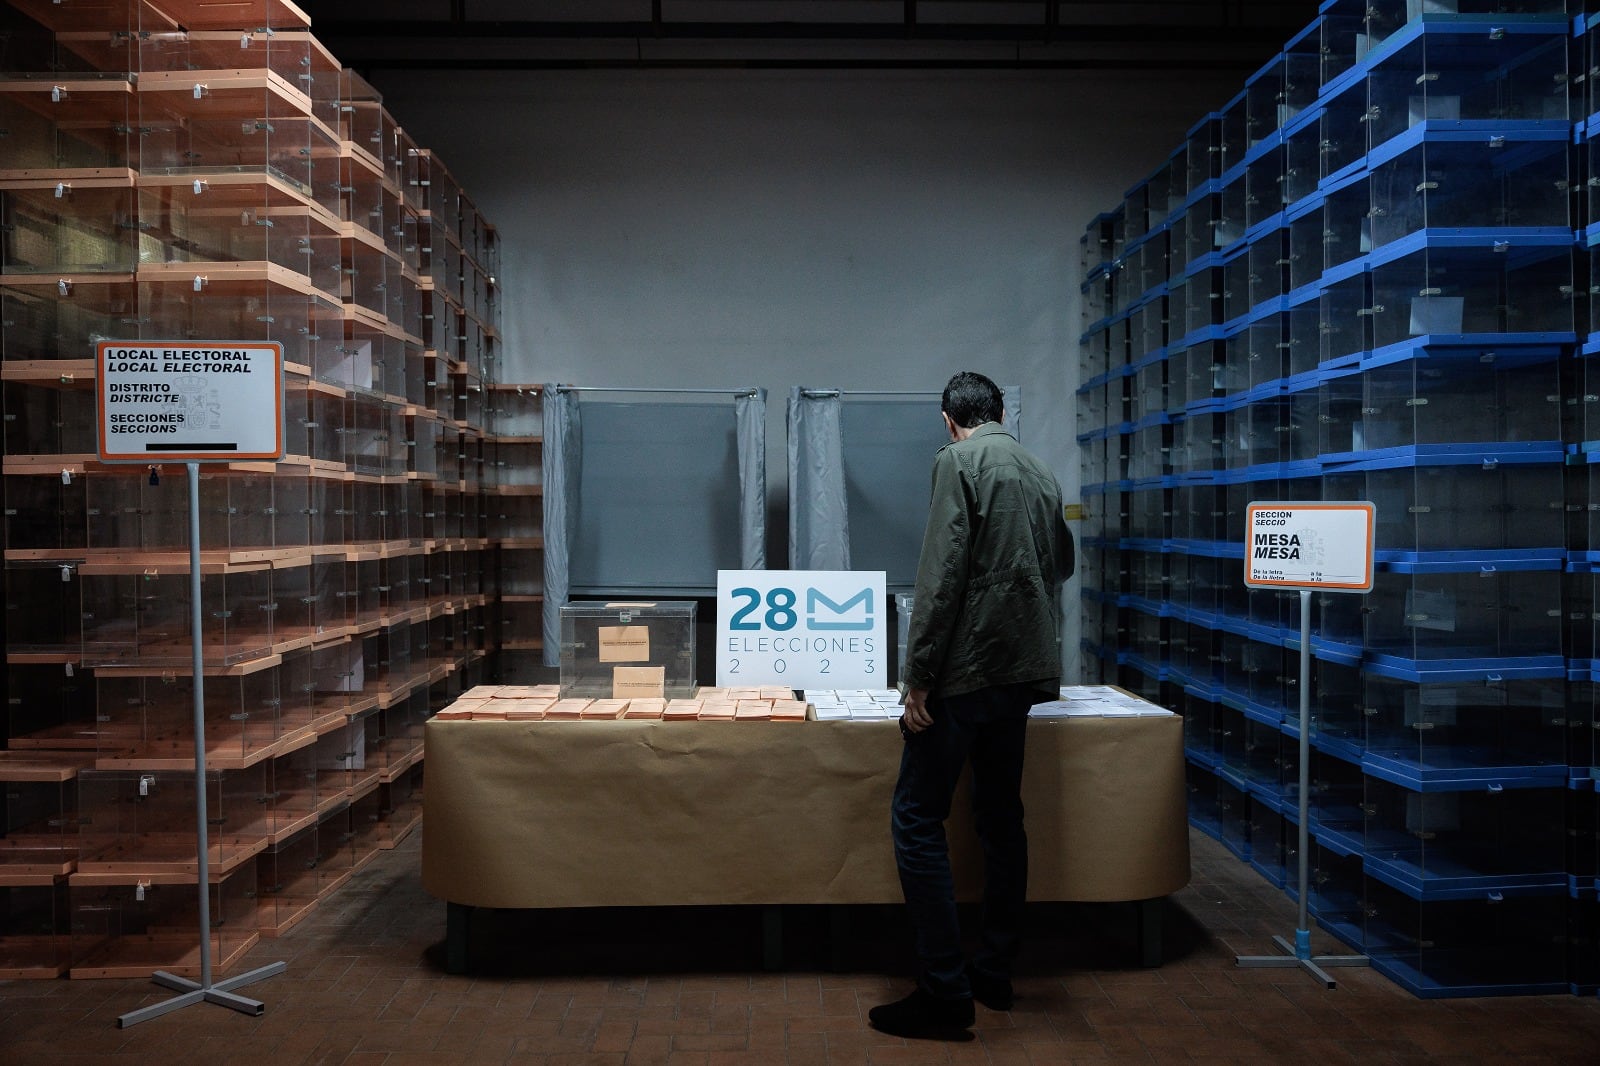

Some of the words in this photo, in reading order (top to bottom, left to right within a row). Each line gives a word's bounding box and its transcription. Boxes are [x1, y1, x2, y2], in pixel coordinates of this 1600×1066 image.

[108, 350, 158, 360] LOCAL
[163, 350, 251, 361] ELECTORAL
[108, 362, 158, 372] LOCAL
[163, 363, 252, 373] ELECTORAL
[109, 383, 171, 392] DISTRITO
[109, 394, 180, 403] DISTRICTE
[110, 414, 185, 423] SECCIONES
[110, 424, 177, 434] SECCIONS
[1254, 534, 1300, 546] MESA
[1254, 547, 1300, 560] MESA
[729, 637, 874, 653] ELECCIONES
